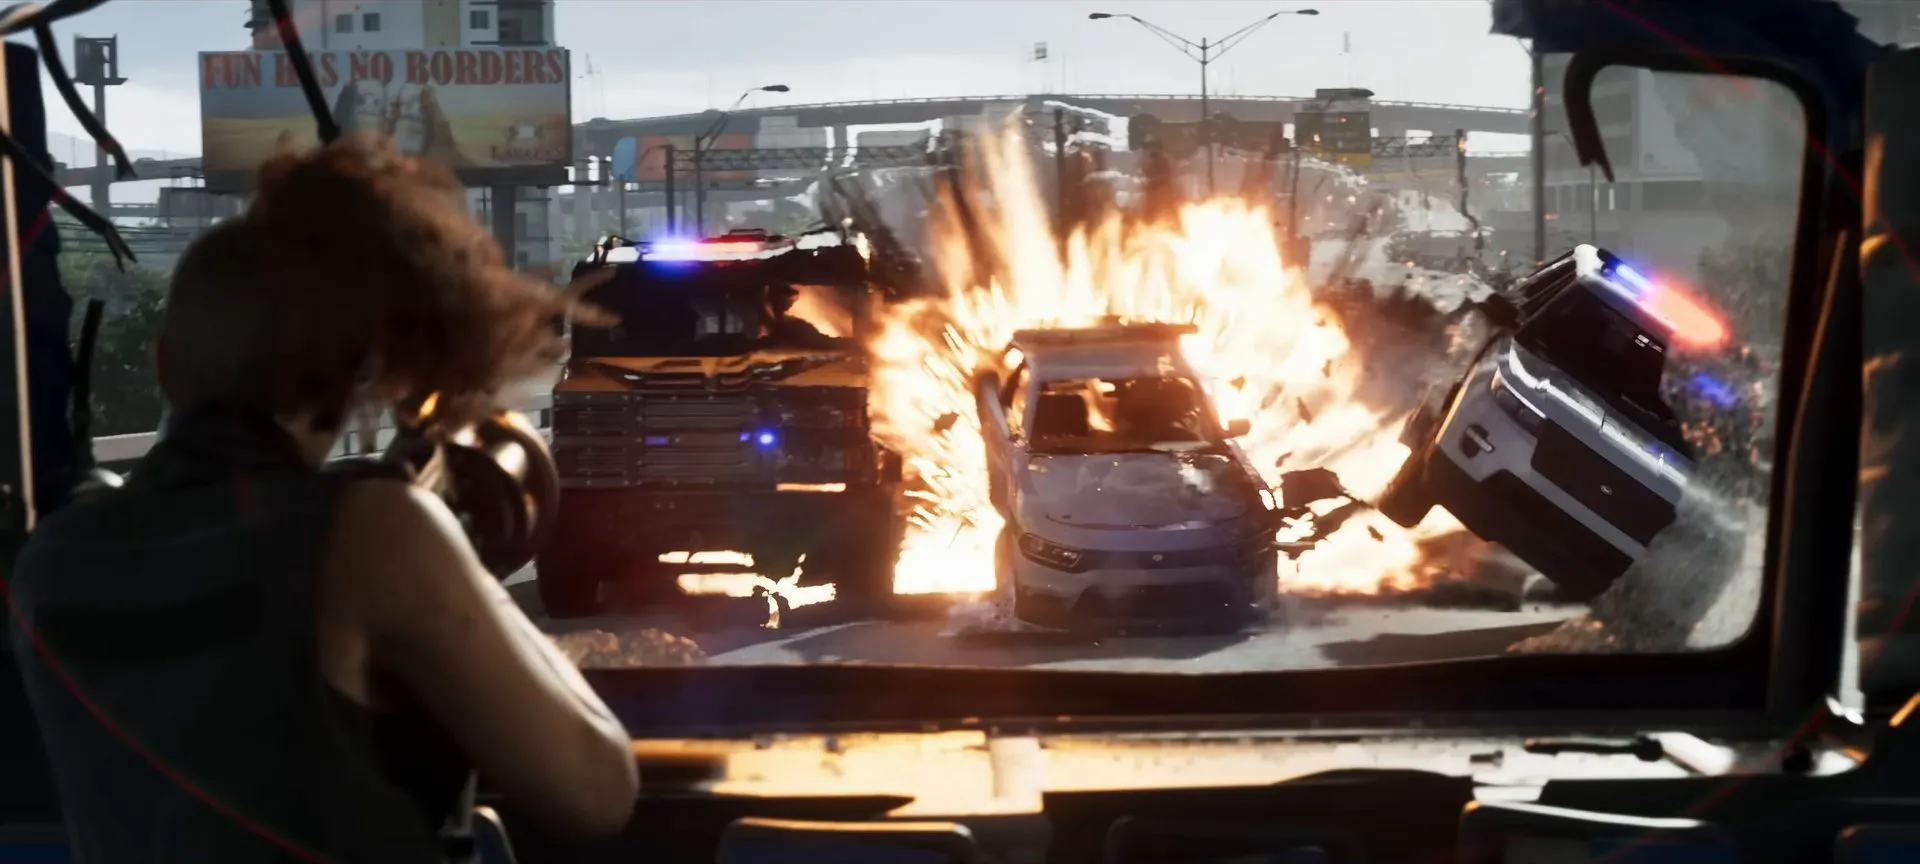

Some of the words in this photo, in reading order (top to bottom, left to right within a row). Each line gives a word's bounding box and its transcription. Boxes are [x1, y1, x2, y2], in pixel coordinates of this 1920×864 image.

[204, 53, 261, 89] FUN
[274, 52, 338, 87] HS
[348, 51, 393, 85] NO
[405, 50, 563, 84] BORDERS
